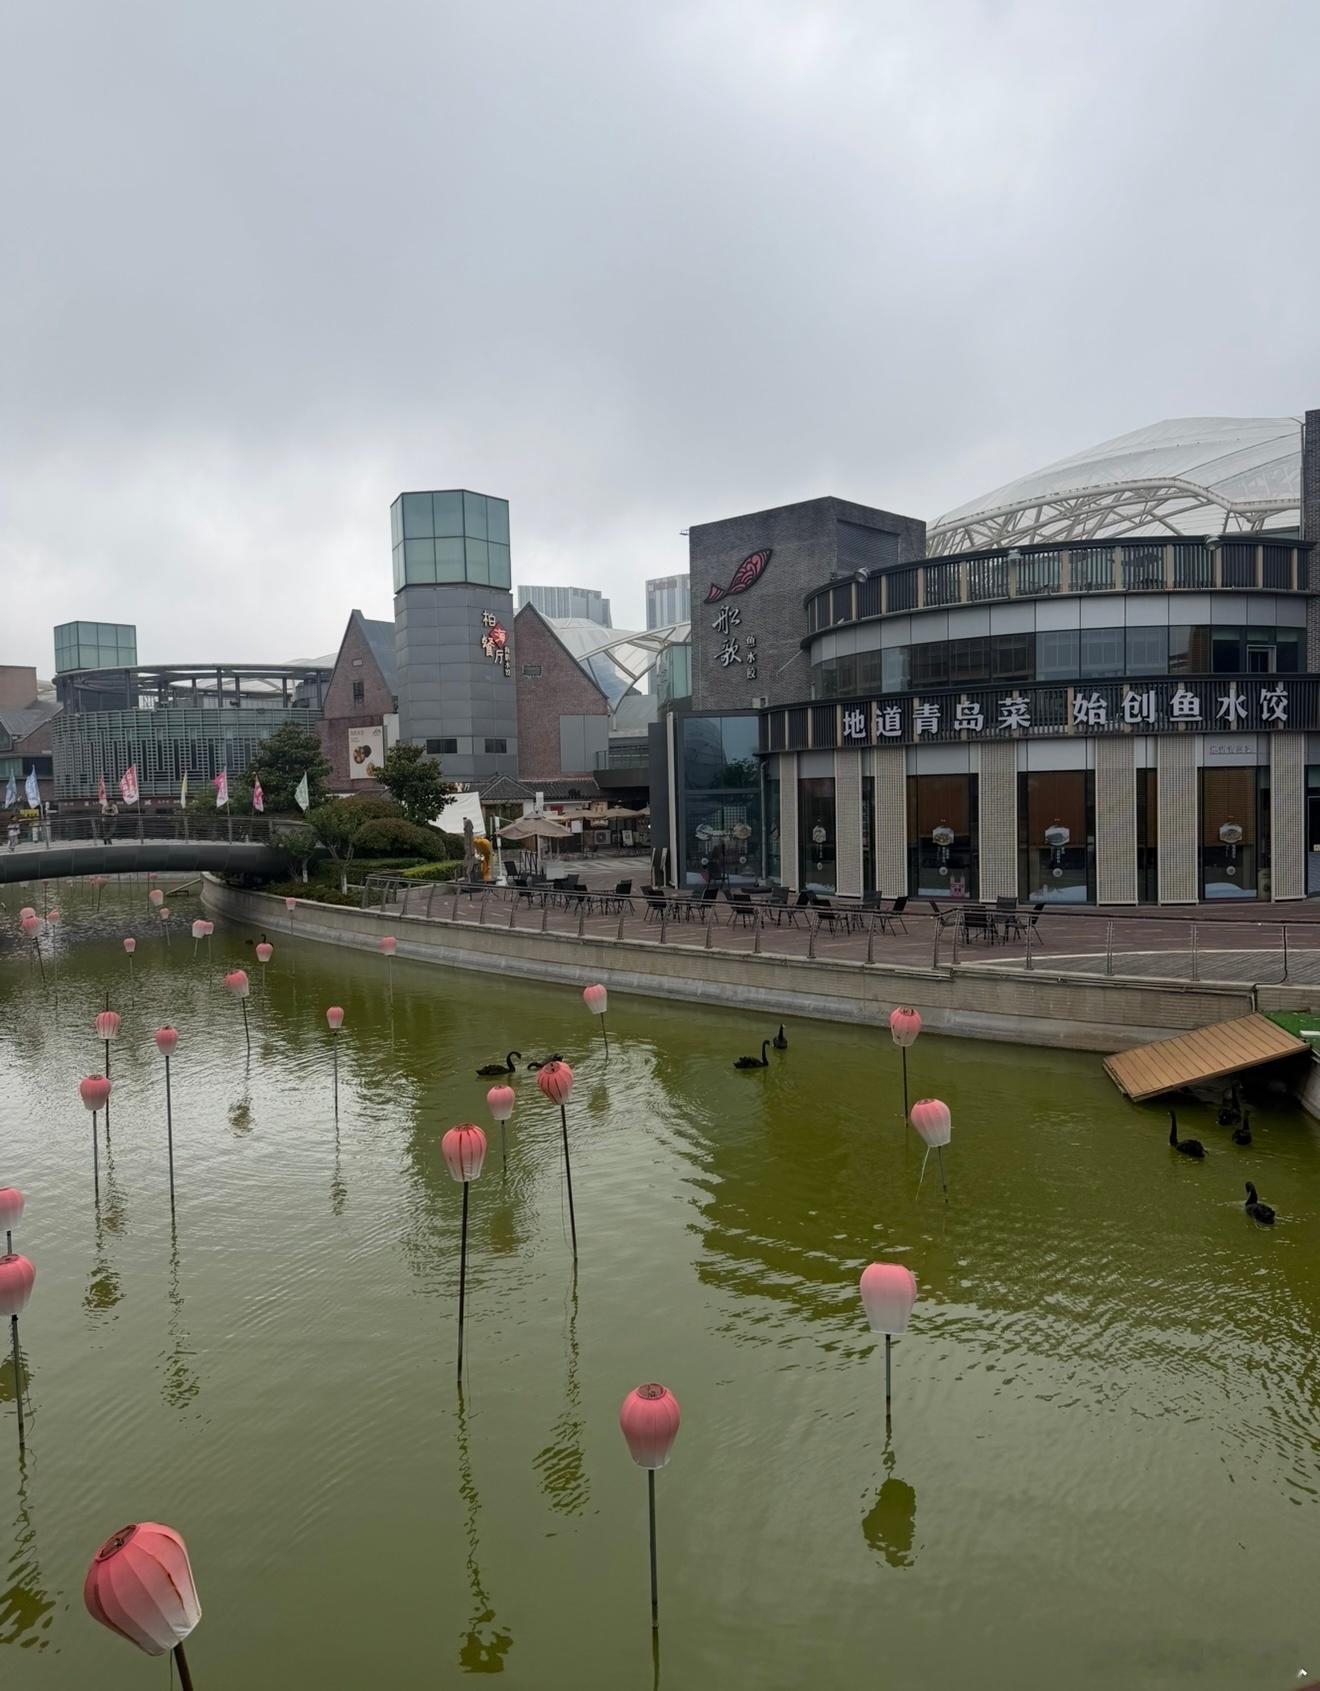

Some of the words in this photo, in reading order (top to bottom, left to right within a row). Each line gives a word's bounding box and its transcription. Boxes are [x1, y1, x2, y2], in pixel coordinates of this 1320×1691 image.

[712, 605, 742, 667] 船歌
[842, 696, 1032, 738] 地道青岛菜
[1072, 686, 1290, 726] 始创鱼水饺
